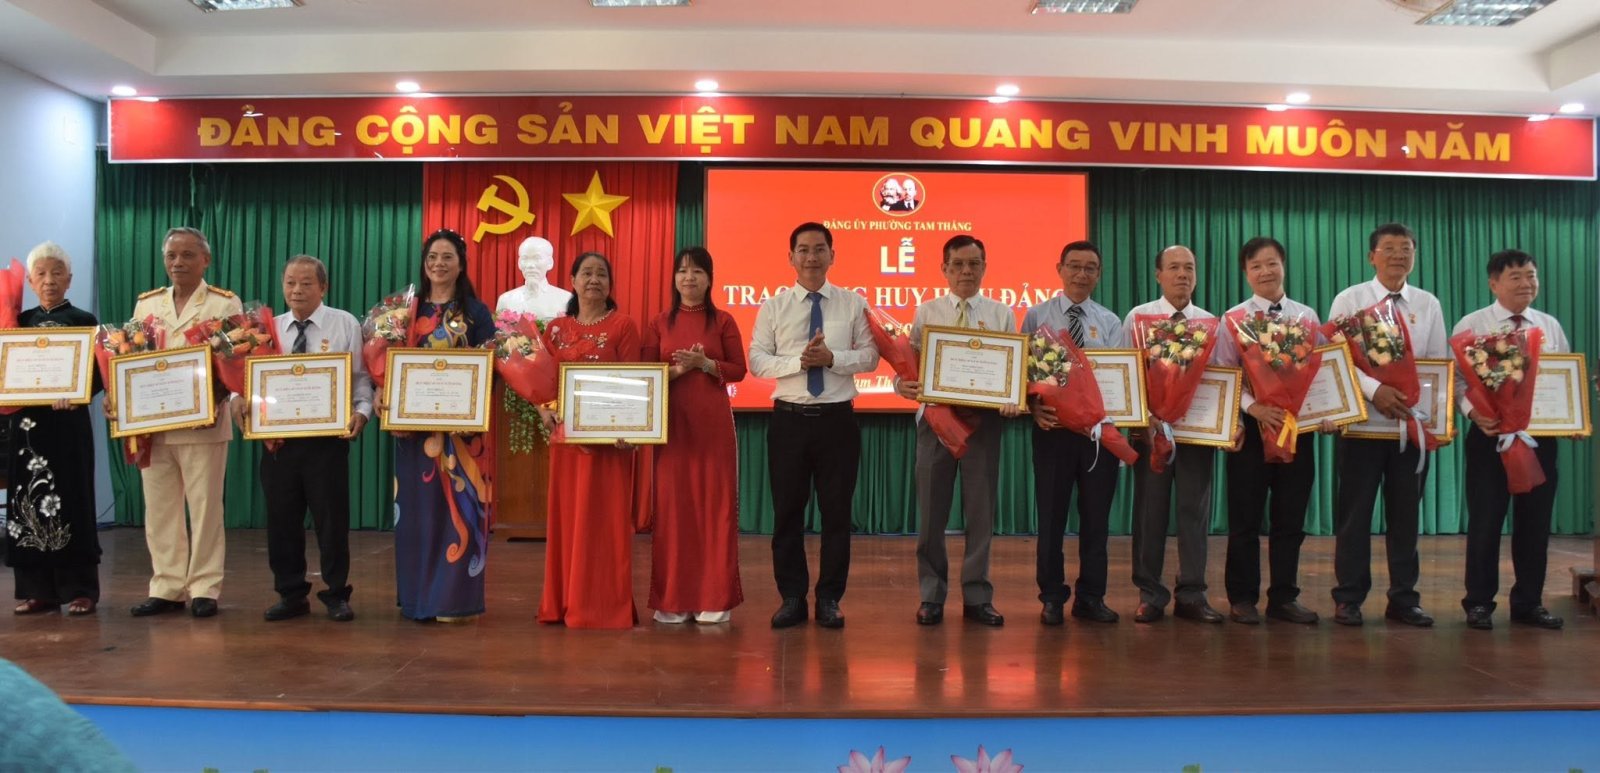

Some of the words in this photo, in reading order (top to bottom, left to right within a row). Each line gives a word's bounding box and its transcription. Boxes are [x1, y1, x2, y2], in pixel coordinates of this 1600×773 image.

[197, 105, 336, 147] ĐẢNG
[355, 105, 498, 154] CỘNG
[516, 102, 619, 145] SẢN
[638, 105, 755, 154] VIỆT
[775, 114, 889, 146] NAM
[910, 116, 1091, 150] QUANG
[1108, 120, 1228, 153] VINH
[1246, 119, 1387, 159] MUÔN
[1405, 121, 1511, 162] NĂM
[823, 219, 851, 230] ĐẢNG
[869, 220, 912, 231] PHƯỜNG
[913, 221, 935, 231] TAM
[880, 237, 916, 274] LỄ
[874, 286, 928, 308] HUY
